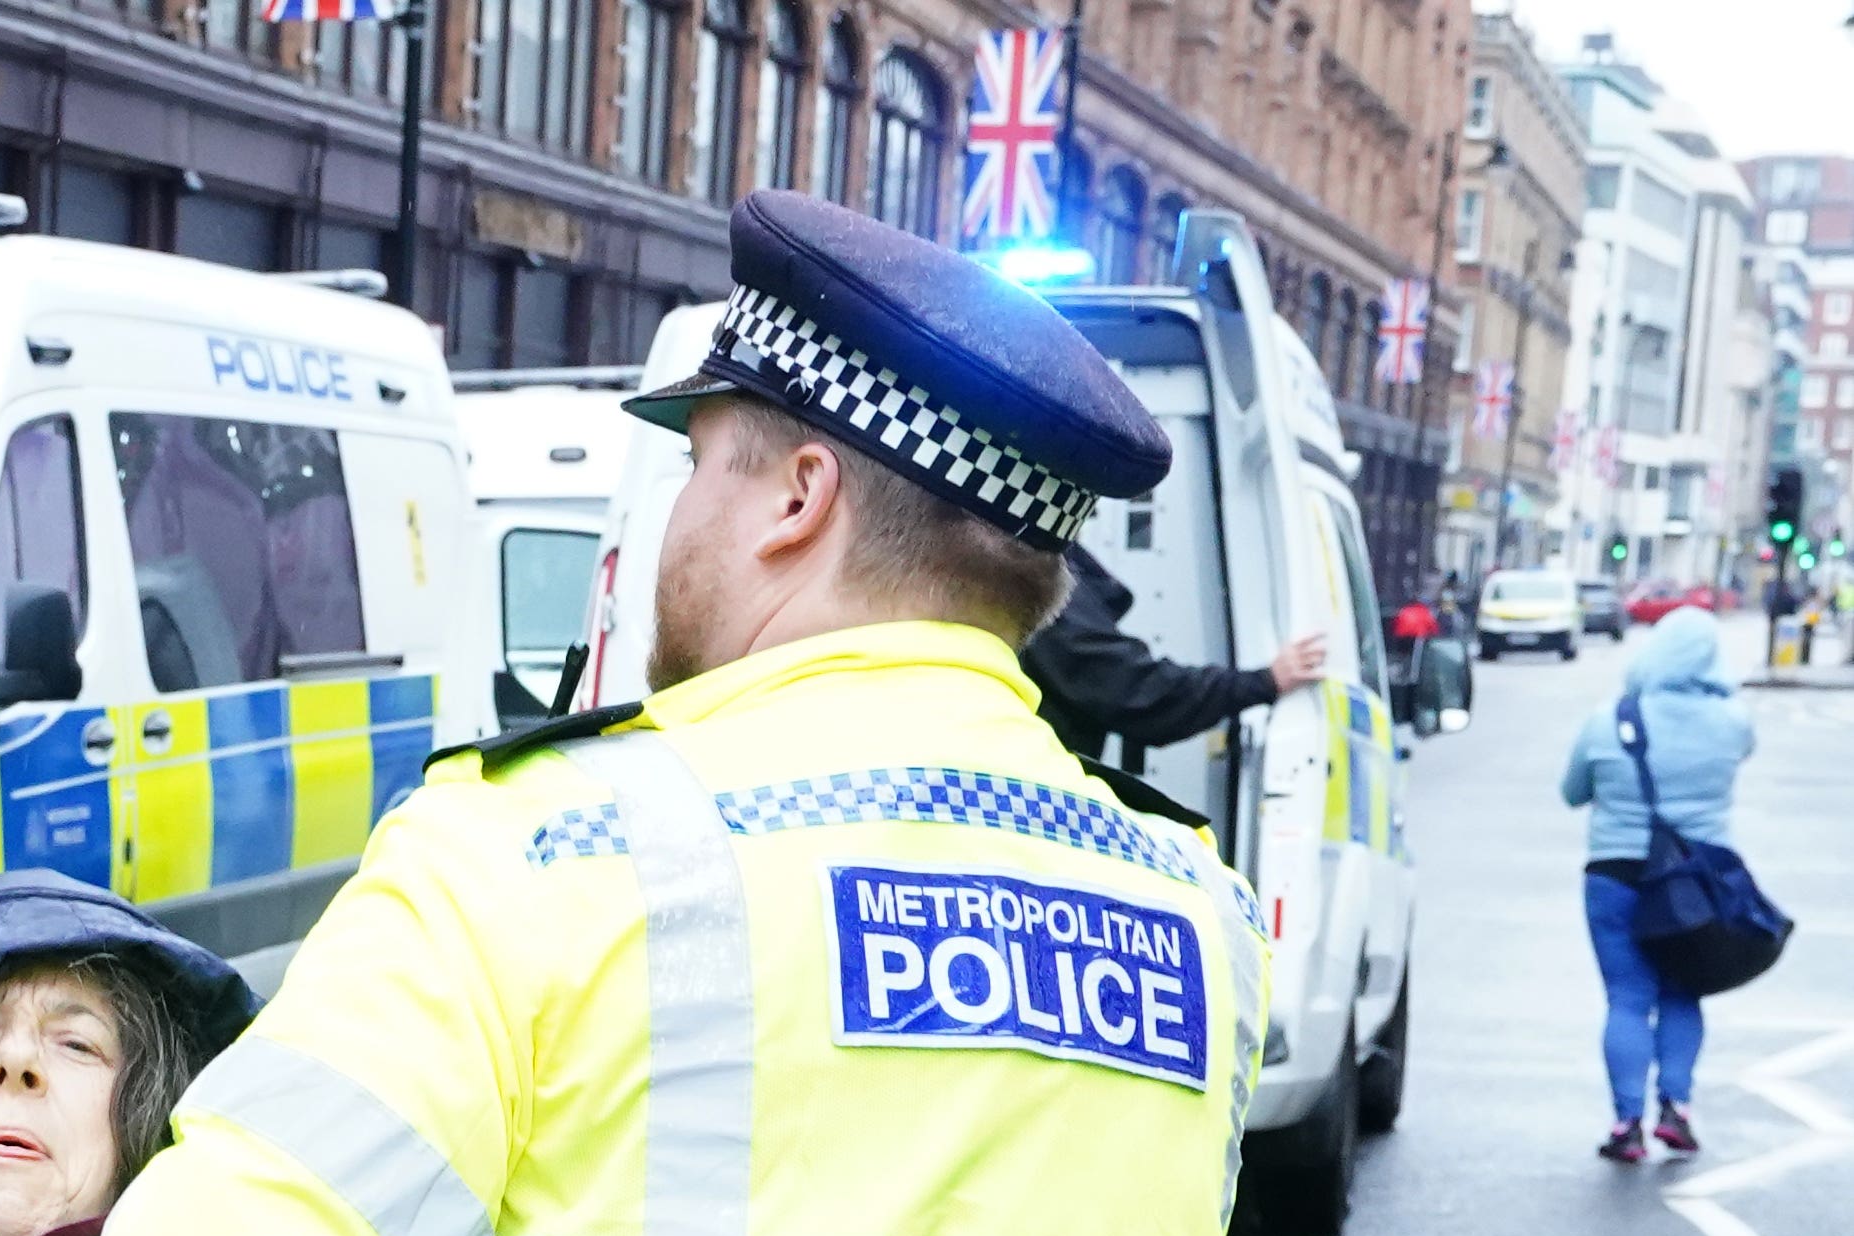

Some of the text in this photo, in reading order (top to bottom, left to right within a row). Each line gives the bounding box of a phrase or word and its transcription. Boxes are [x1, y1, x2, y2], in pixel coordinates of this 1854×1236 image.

[207, 336, 353, 401] POLICE
[856, 880, 1182, 968] METROPOLITAN
[863, 932, 1191, 1061] POLICE
